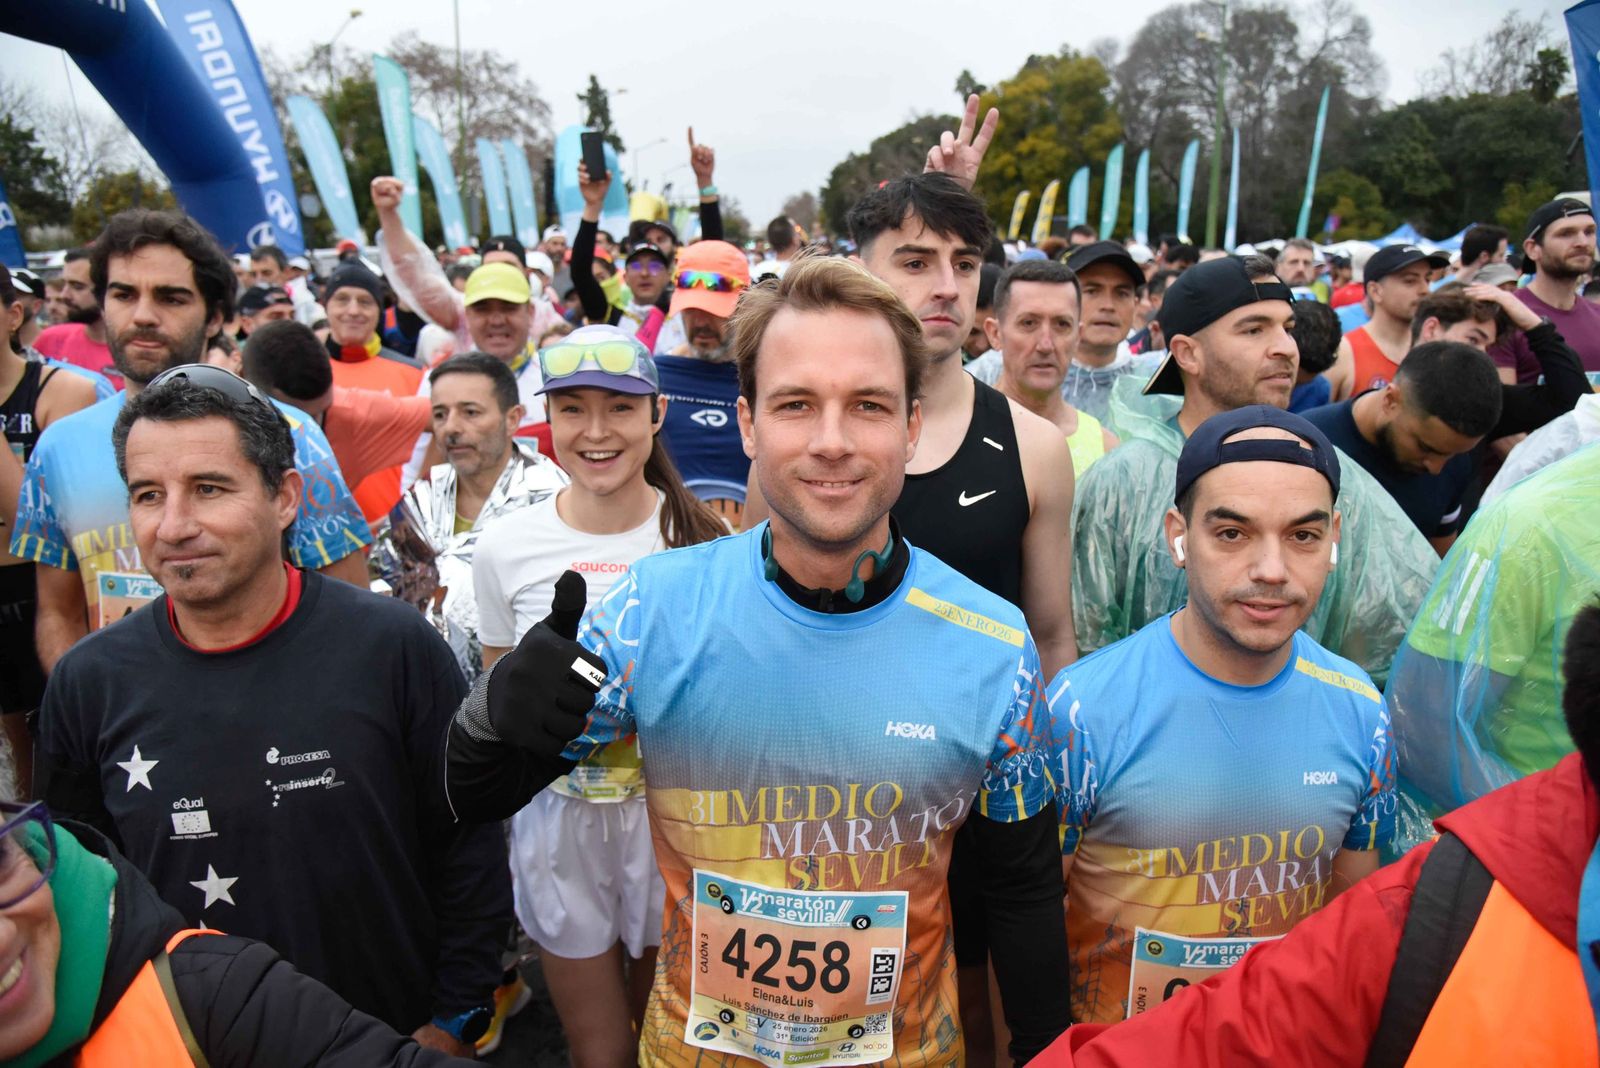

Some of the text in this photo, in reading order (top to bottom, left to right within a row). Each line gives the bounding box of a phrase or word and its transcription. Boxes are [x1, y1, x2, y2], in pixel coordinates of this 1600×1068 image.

[571, 561, 631, 573] saucon
[933, 601, 1012, 641] 25ENERO26
[589, 671, 604, 684] KAL
[884, 720, 936, 740] HOKA
[280, 750, 331, 766] PROCESA
[1303, 771, 1338, 785] HOKA
[172, 797, 204, 811] eQual
[728, 781, 904, 824] MEDIO
[1168, 824, 1325, 877] MEDIO
[758, 892, 835, 910] maratón
[777, 906, 836, 923] sevilla
[721, 928, 850, 994] 4258
[752, 987, 814, 1008] Elena&Luis
[723, 994, 741, 1008] Luis
[744, 1001, 785, 1020] Sánchez
[788, 1013, 801, 1022] de
[804, 1012, 849, 1024] Ibargüen
[772, 1022, 828, 1033] 25 enero 2026
[753, 1044, 781, 1059] HOKA
